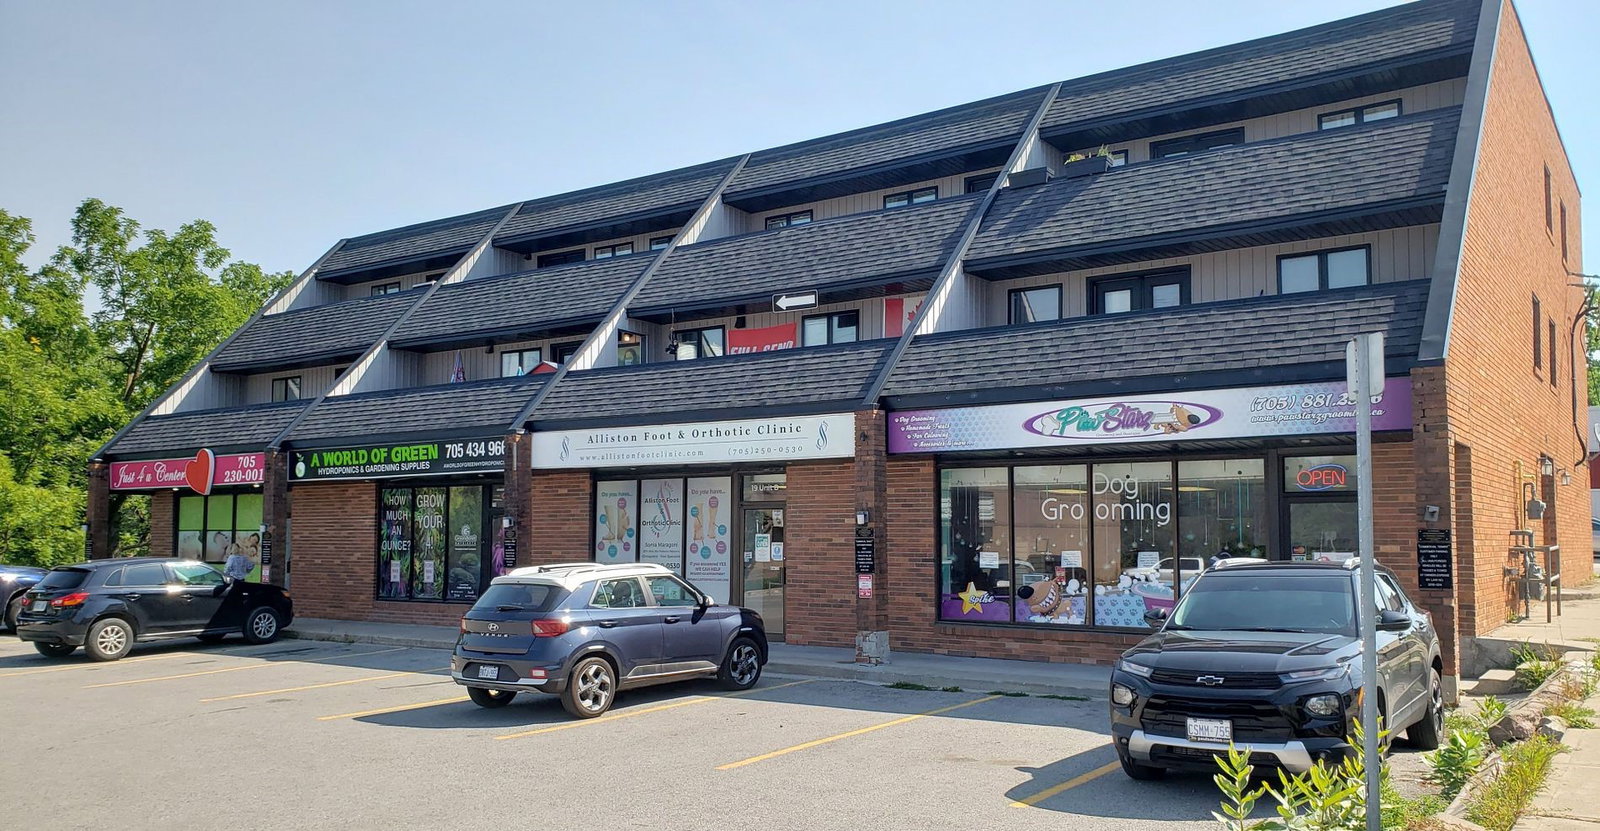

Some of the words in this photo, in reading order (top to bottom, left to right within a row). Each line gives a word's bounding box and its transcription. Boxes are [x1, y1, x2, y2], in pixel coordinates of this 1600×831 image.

[1251, 395, 1297, 412] (705)
[1301, 390, 1384, 411] 881.26
[899, 416, 910, 424] Dog
[587, 432, 637, 444] Alliston
[644, 431, 672, 442] Foot
[678, 430, 685, 438] &
[691, 426, 751, 439] Orthotic
[757, 423, 802, 434] Clinic
[310, 455, 321, 468] A
[323, 449, 369, 466] WORLD
[371, 447, 388, 463] OF
[391, 443, 439, 463] GREEN
[445, 444, 463, 459] 705
[466, 442, 486, 457] 434
[579, 450, 704, 461] www.allistonfootclinic.com
[728, 445, 803, 455] (705)250-0530
[237, 456, 256, 469] 705
[318, 465, 360, 476] HYDROPONICS
[360, 465, 365, 473] &
[365, 464, 400, 473] GARDENING
[400, 461, 430, 471] SUPPLIES
[114, 463, 135, 488] Just
[136, 465, 147, 483] 4
[154, 461, 186, 483] Center
[1296, 470, 1346, 486] OPEN
[699, 489, 709, 497] you
[751, 484, 758, 492] 19
[1092, 472, 1139, 500] Dog
[389, 495, 407, 505] HOW
[416, 494, 445, 508] GROW
[386, 510, 408, 521] MUCH
[417, 515, 443, 529] YOUR
[391, 525, 402, 536] AN
[381, 540, 411, 551] OUNCE?
[968, 592, 995, 604] Spike
